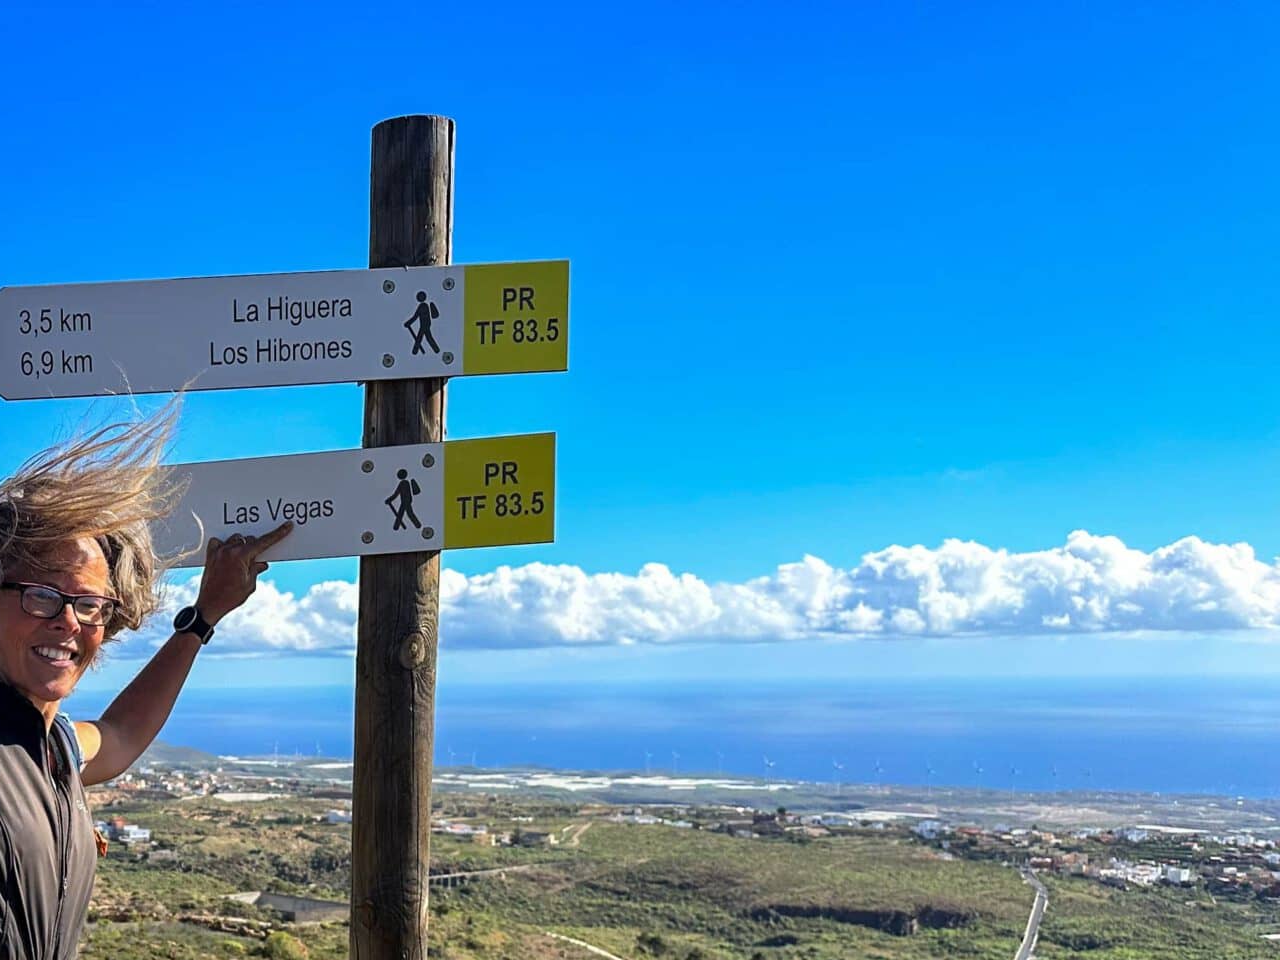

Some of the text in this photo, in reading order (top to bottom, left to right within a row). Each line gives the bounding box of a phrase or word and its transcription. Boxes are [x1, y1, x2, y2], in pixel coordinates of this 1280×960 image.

[233, 295, 352, 326] La Higuera
[502, 287, 535, 312] PR
[19, 308, 92, 337] 3,5 km
[475, 318, 559, 345] TF 83.5
[21, 349, 93, 379] 6,9 km
[210, 337, 352, 366] Los Hibrones
[485, 461, 519, 487] PR
[223, 497, 334, 525] Las Vegas
[456, 491, 545, 520] TF 83.5
